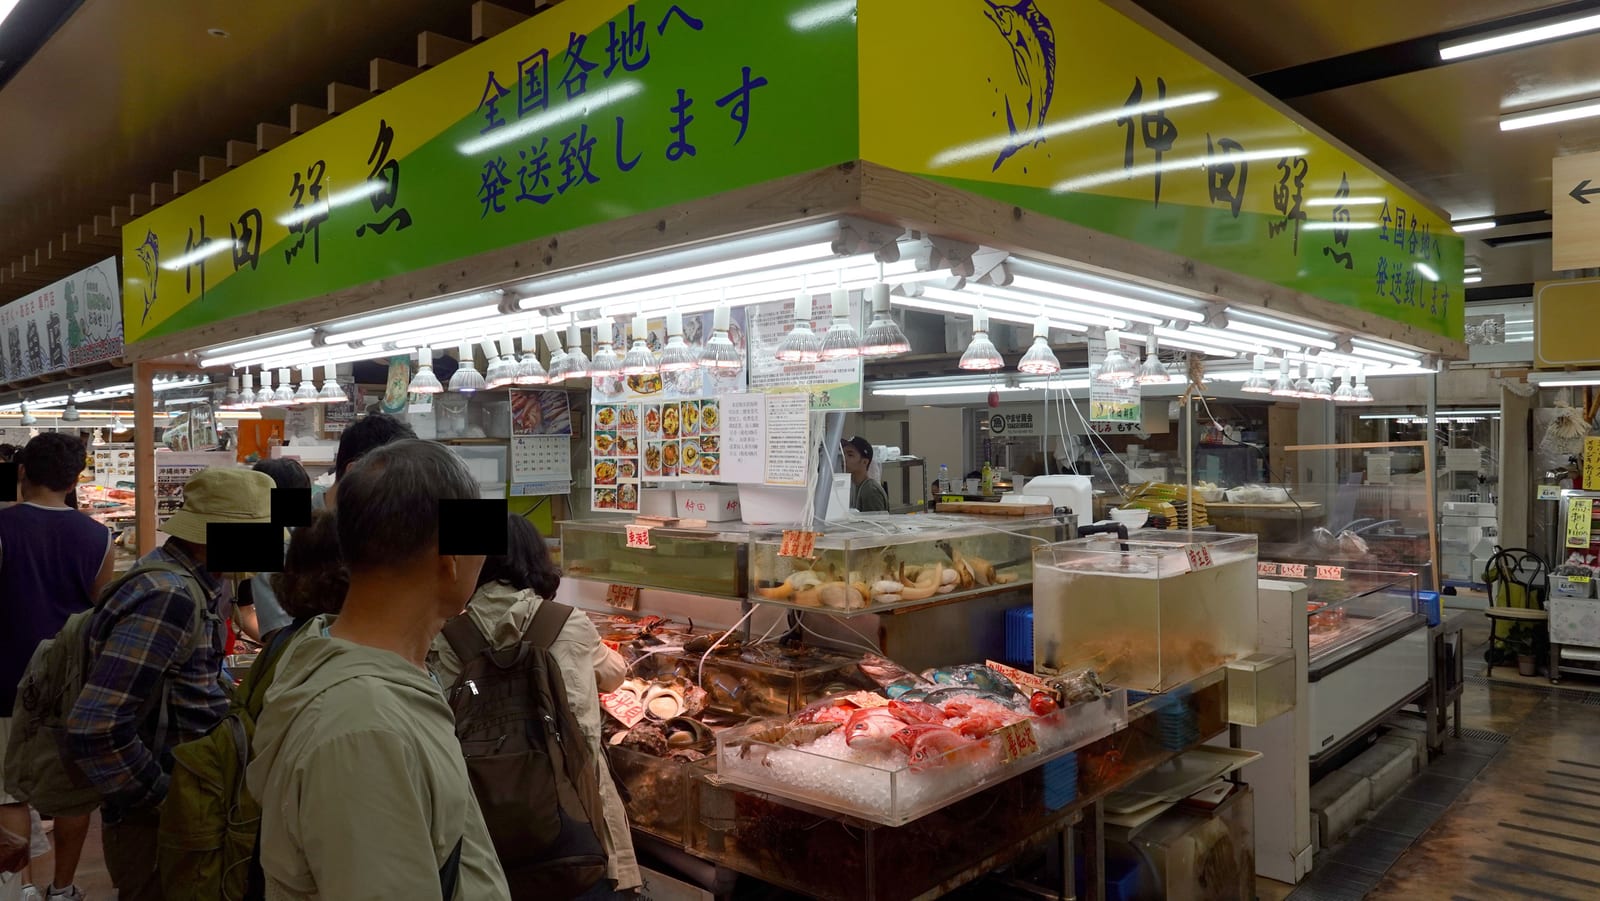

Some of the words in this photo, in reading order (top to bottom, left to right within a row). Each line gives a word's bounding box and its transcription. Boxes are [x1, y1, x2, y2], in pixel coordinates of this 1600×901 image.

[474, 3, 705, 137] 全国各地へ
[477, 66, 769, 220] 発送致します
[1379, 197, 1442, 261] 全国各地へ
[1375, 256, 1450, 319] 発送致します
[1117, 423, 1141, 432] もずく
[1281, 566, 1303, 574] いくら
[1318, 567, 1341, 576] いくら
